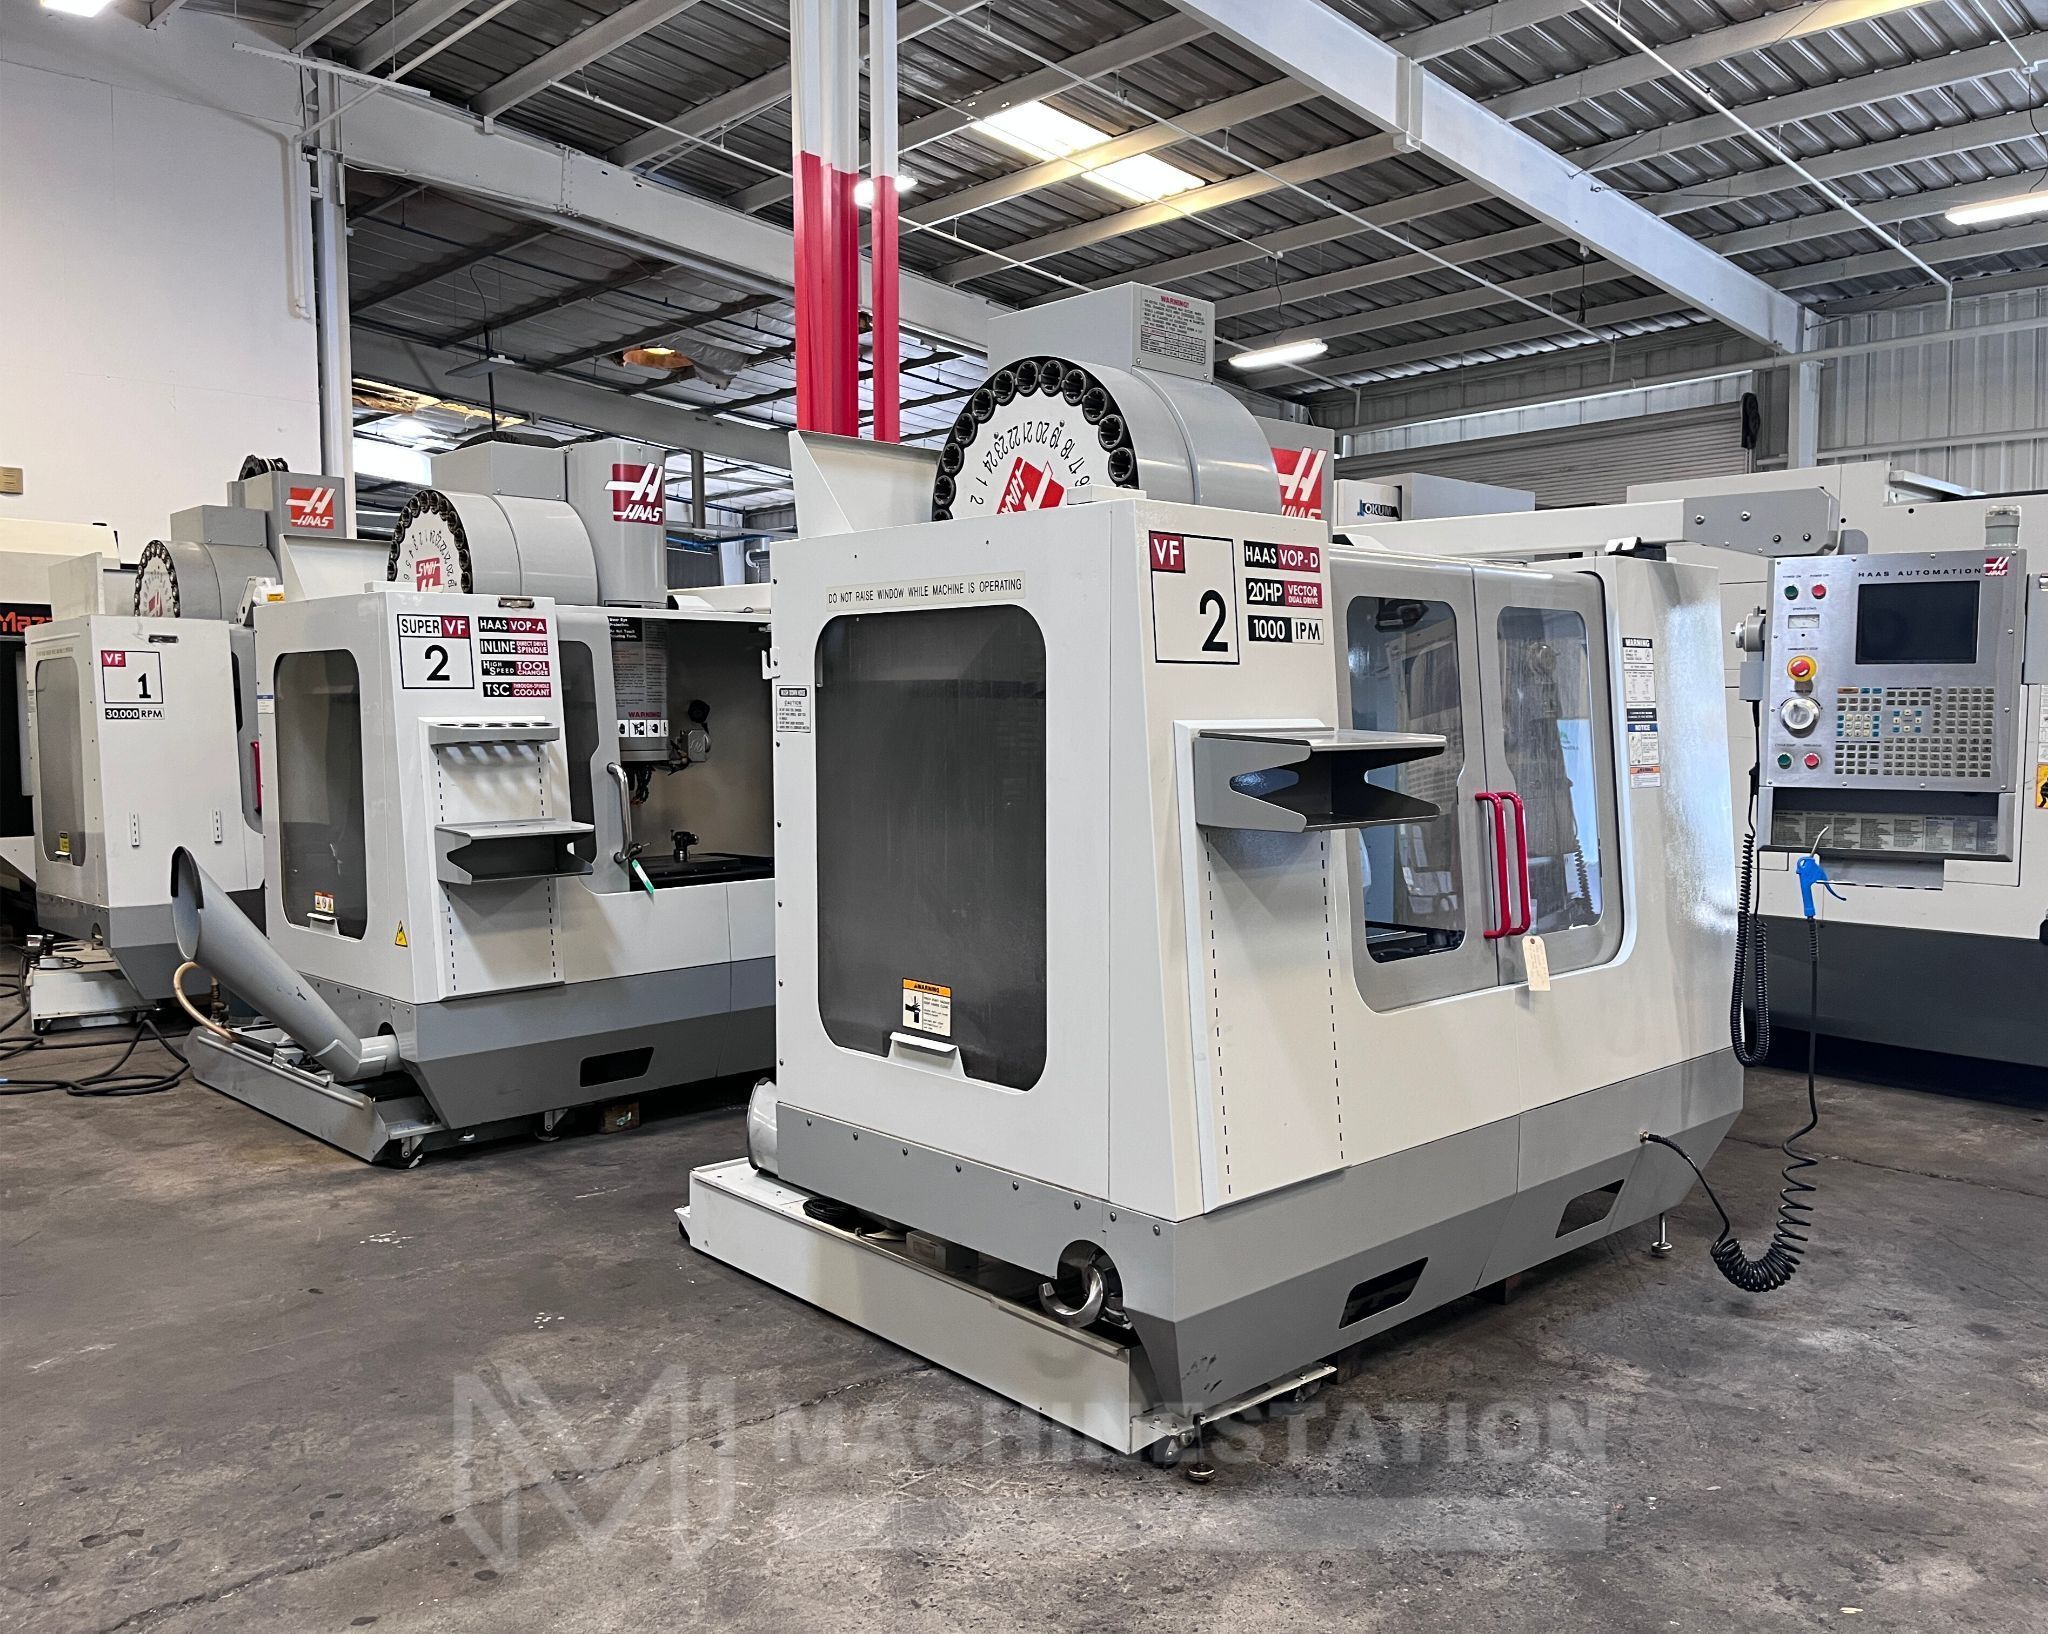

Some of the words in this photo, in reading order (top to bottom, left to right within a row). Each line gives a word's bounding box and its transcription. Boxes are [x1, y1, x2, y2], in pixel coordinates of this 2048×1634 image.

[994, 435, 1009, 460] 23
[1007, 425, 1021, 449] 22
[1023, 421, 1033, 443] 21
[1036, 421, 1050, 444] 20
[1049, 427, 1063, 450] 19
[1060, 438, 1076, 460] 18
[613, 504, 663, 522] HAAS
[291, 516, 334, 527] HAAS
[1153, 538, 1180, 566] VF
[1245, 545, 1277, 565] HAAS
[1279, 549, 1319, 568] VOP-D
[1898, 568, 1982, 576] AUTOMATION
[828, 593, 838, 604] DO
[840, 592, 852, 603] NOT
[855, 590, 874, 602] RAISE
[877, 587, 905, 600] WINDOW
[908, 585, 929, 598] WHILE
[932, 582, 964, 596] MACHINE
[968, 582, 975, 593] IS
[979, 578, 1022, 593] OPERATING
[1248, 581, 1283, 602] 20HP
[1287, 584, 1318, 597] VECTOR
[1288, 595, 1302, 604] DUAL
[1303, 597, 1319, 605] DRIVE
[401, 618, 440, 634] SUPER
[444, 619, 466, 635] VF
[480, 620, 508, 630] HAAS
[509, 620, 546, 632] VOP-A
[1199, 589, 1229, 652] 2
[1253, 619, 1286, 639] 1000
[1295, 621, 1321, 641] IPM
[480, 640, 516, 653] INLINE
[517, 646, 547, 654] SPINDLE
[104, 653, 123, 665] VF
[424, 644, 450, 681] 2
[516, 661, 548, 671] TOOL
[137, 673, 151, 699] 1
[485, 684, 510, 696] TSC
[513, 688, 550, 696] COOLANT
[141, 709, 163, 718] RPM
